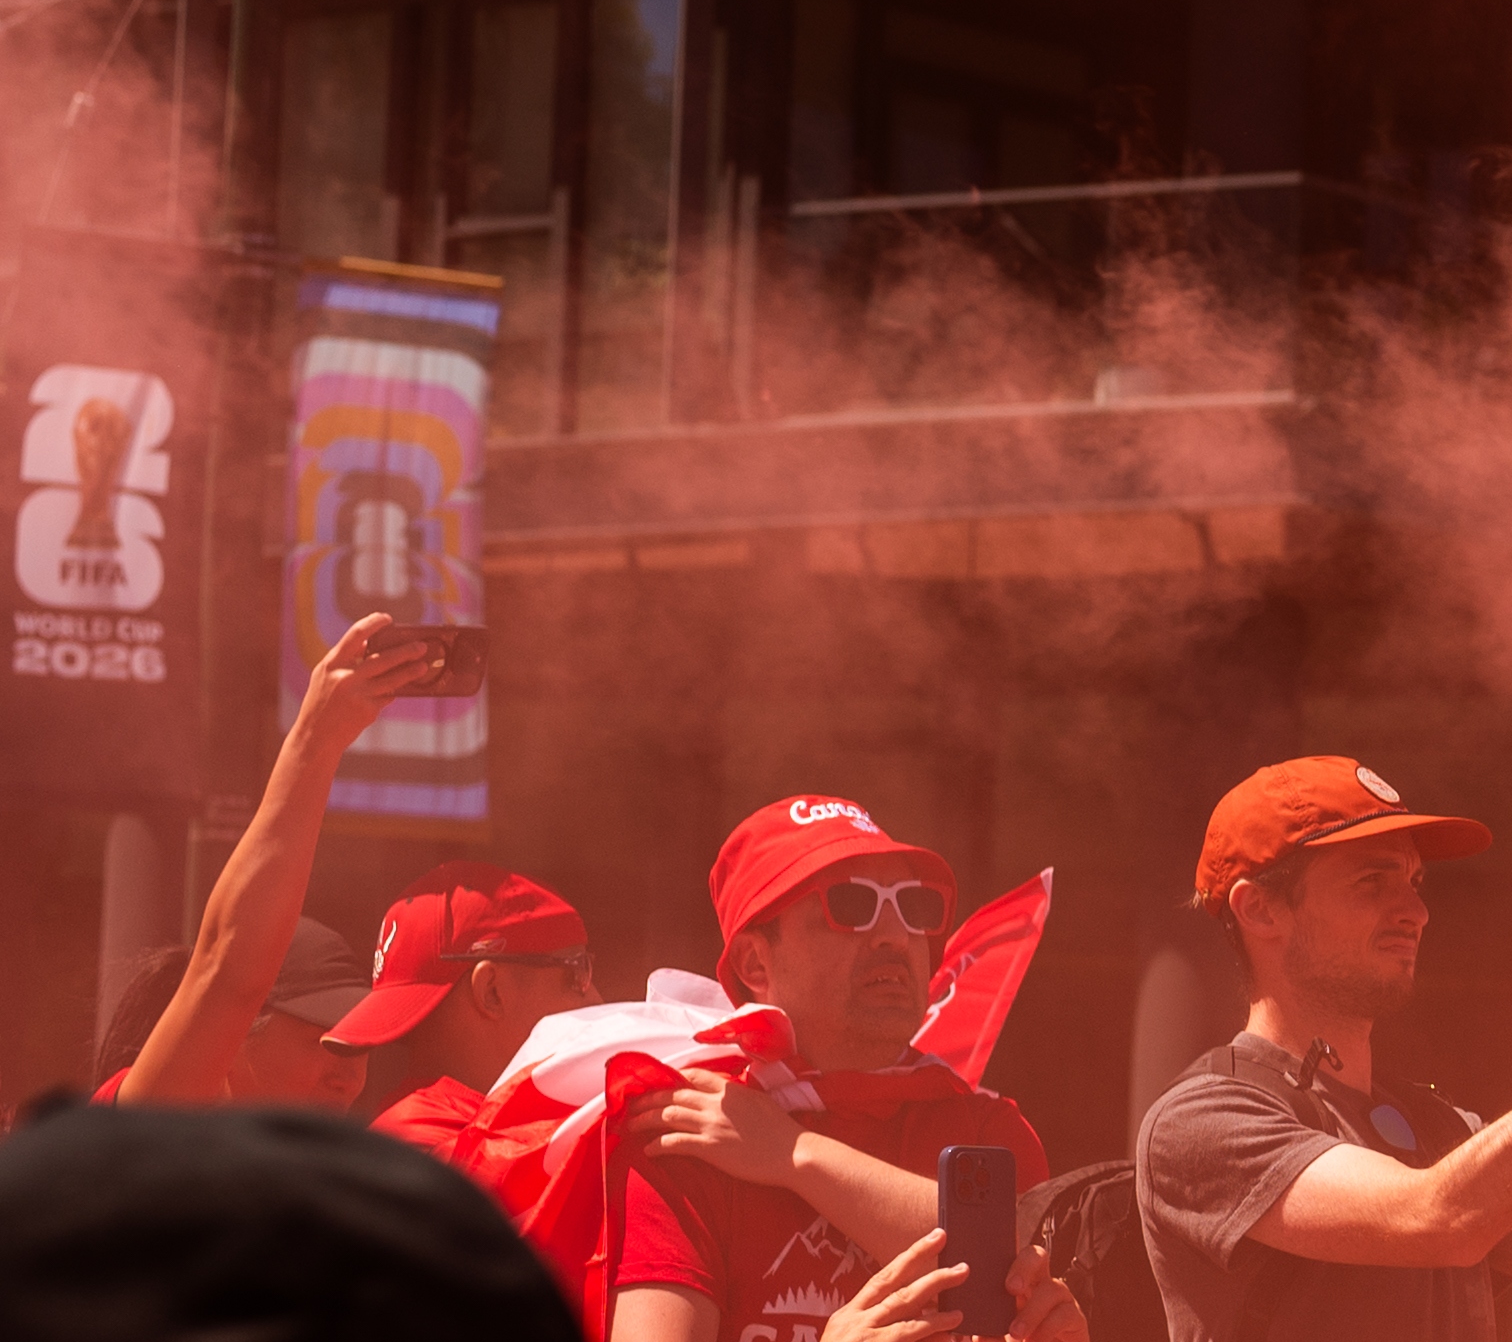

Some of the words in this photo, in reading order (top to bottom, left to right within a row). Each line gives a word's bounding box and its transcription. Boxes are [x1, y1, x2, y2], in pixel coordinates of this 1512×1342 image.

[59, 559, 129, 587] FIFA
[13, 612, 113, 641] WORLD
[116, 616, 165, 643] CUP
[12, 638, 168, 684] 2026
